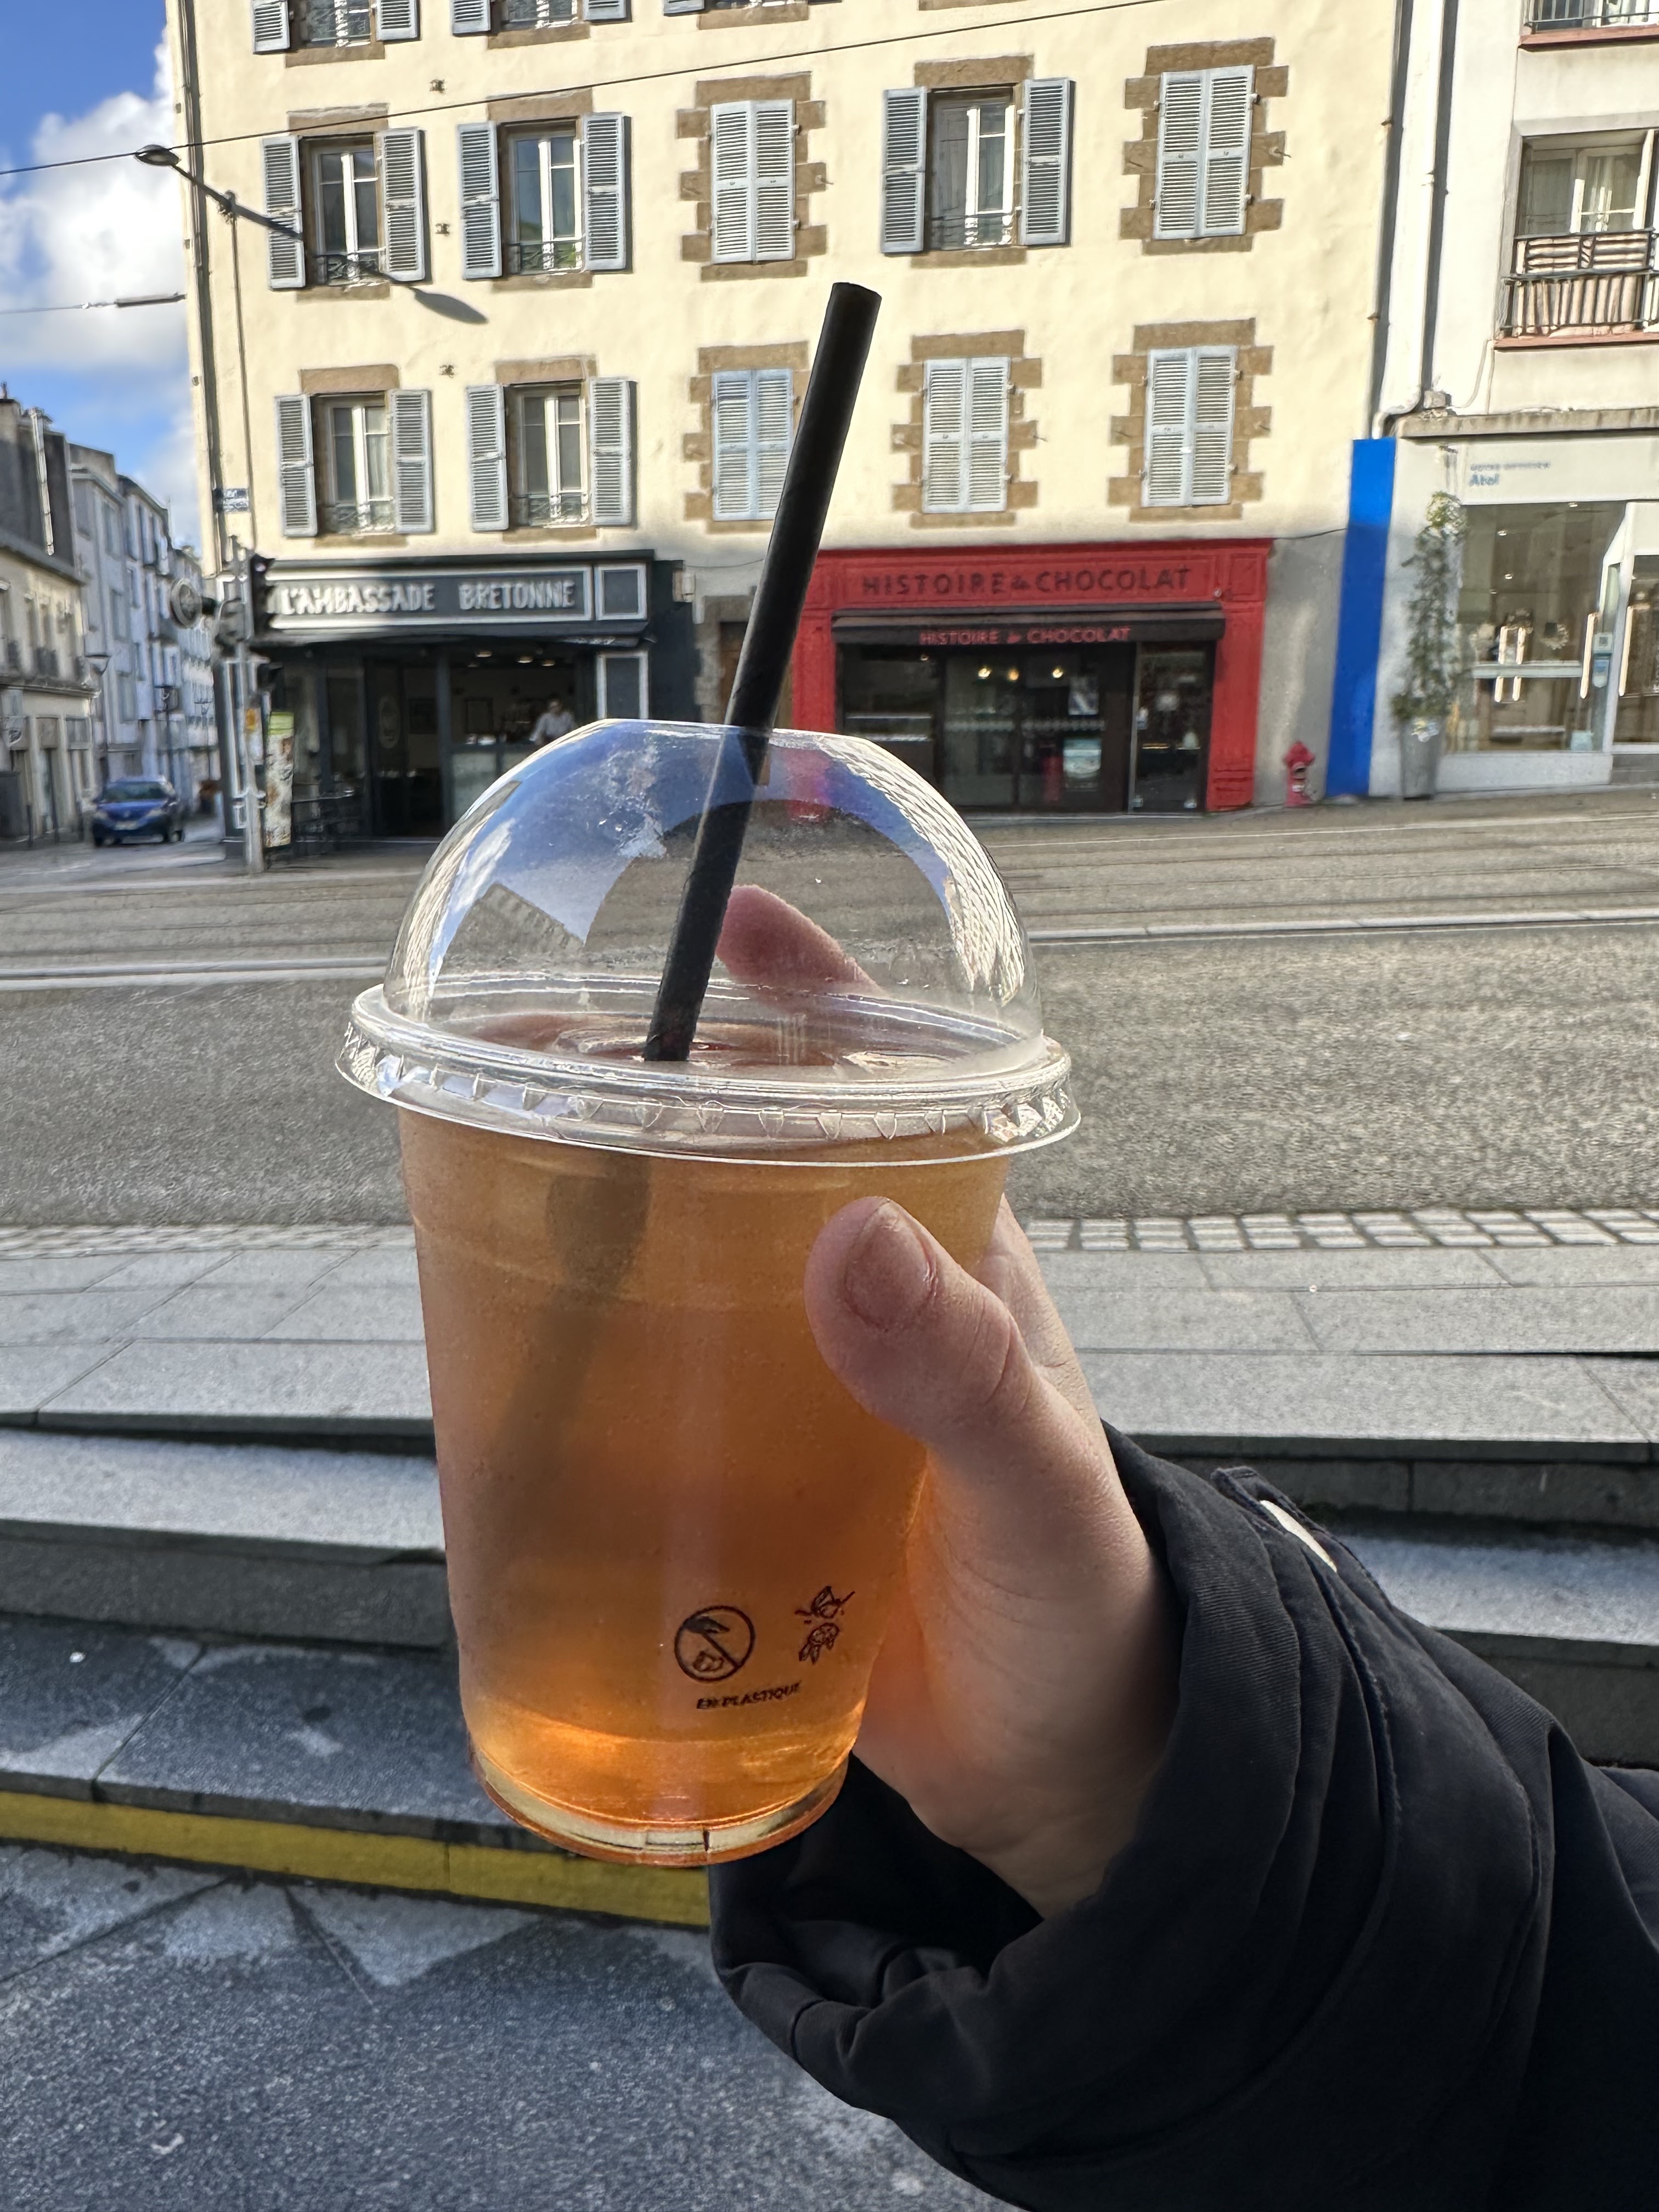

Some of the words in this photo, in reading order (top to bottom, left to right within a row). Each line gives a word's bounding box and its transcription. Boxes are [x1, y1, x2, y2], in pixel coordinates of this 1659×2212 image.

[862, 572, 1005, 595] HISTOIRE
[1035, 566, 1190, 592] CHOCOLAT
[279, 583, 436, 614] L'AMBASSADE
[459, 580, 575, 610] BRETONNE
[918, 630, 999, 645] HISTOIRE
[1026, 625, 1131, 643] CHOCOLAT
